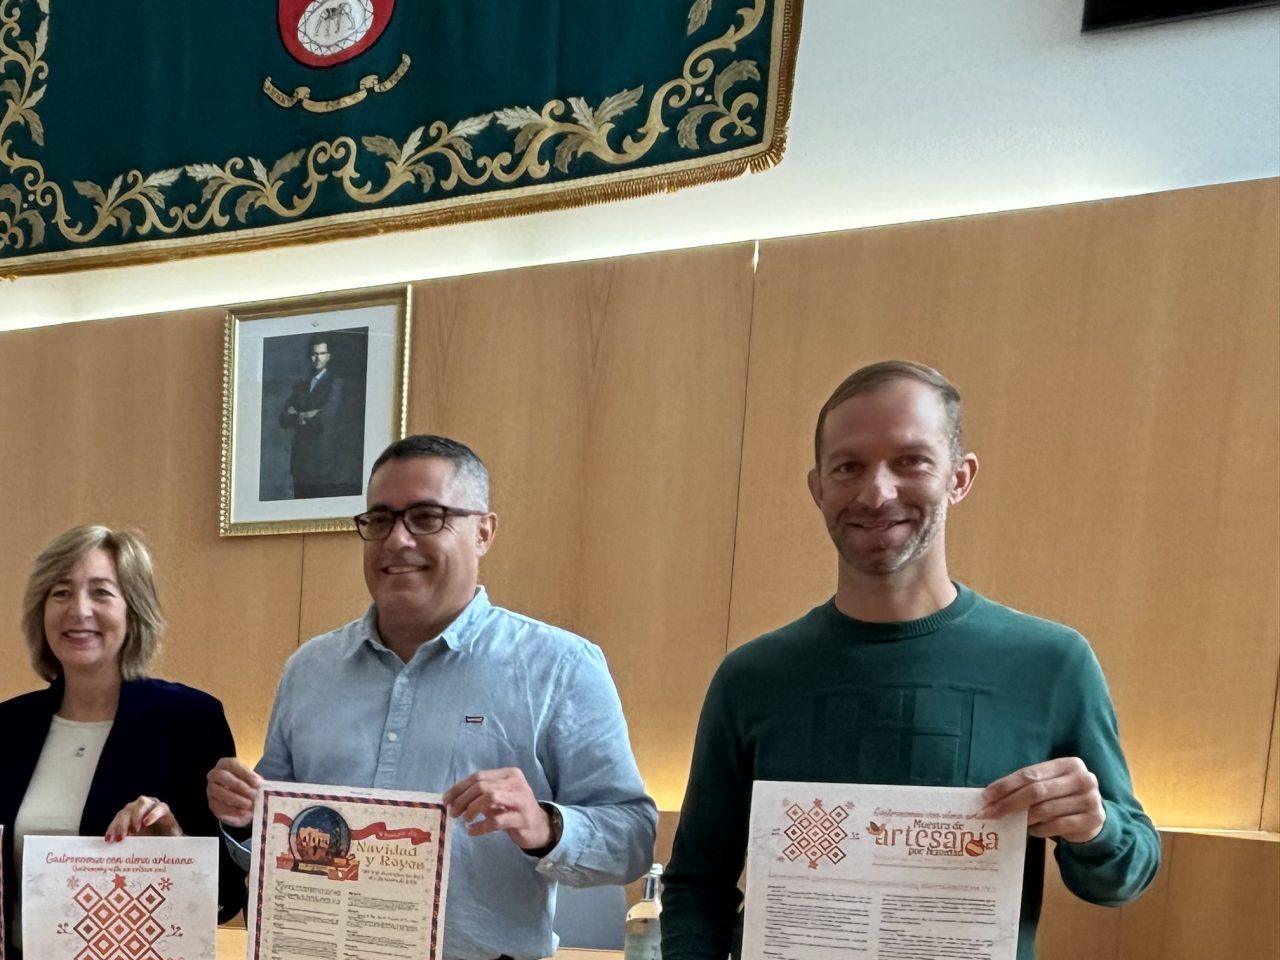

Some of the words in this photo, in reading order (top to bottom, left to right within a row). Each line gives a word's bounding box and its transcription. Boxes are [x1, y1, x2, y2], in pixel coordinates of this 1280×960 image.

[913, 819, 950, 830] Muestra
[952, 820, 965, 831] de
[875, 823, 1000, 851] artesanía
[356, 841, 417, 856] Navidad
[365, 855, 375, 867] y
